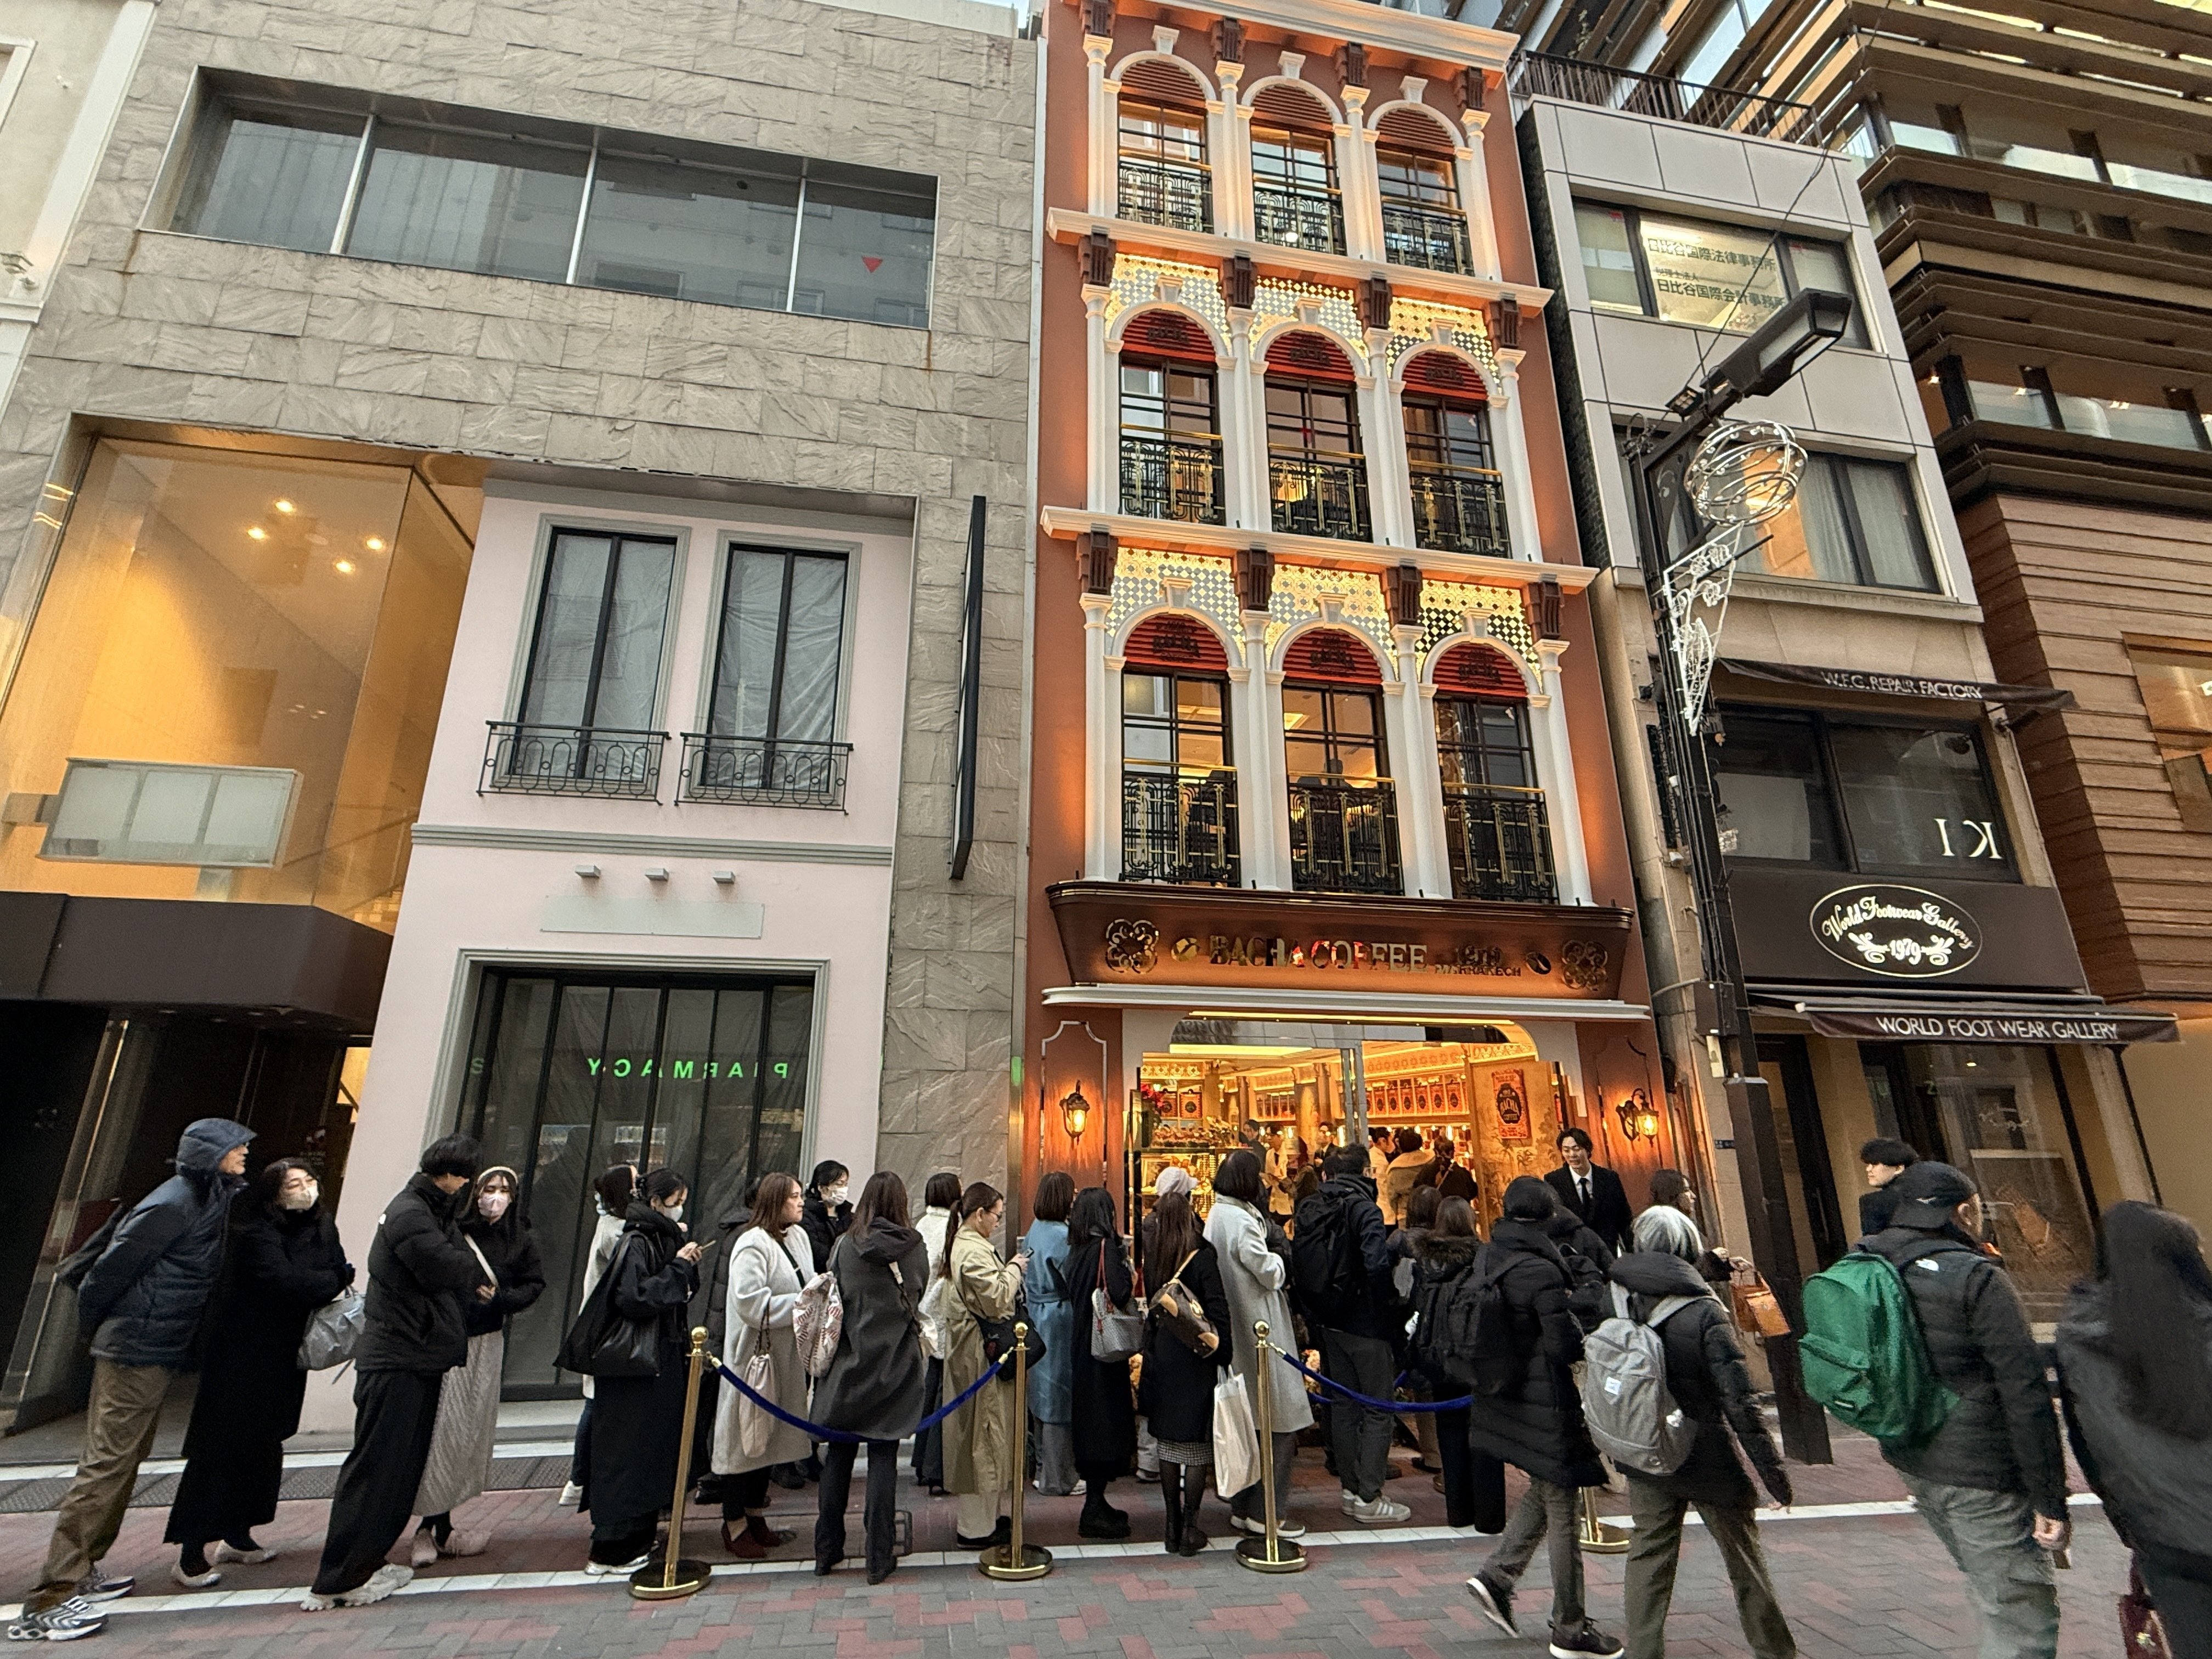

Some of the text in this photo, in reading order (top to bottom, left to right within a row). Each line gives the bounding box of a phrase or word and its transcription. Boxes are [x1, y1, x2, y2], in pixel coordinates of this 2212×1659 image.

[1920, 680, 1984, 699] FACTORY
[1821, 895, 1975, 950] World Footwear Gallery
[1210, 935, 1427, 973] BACHA COFFEE
[1889, 938, 1922, 966] 1979
[1435, 964, 1522, 977] MARRAKECH
[1876, 1016, 2119, 1040] WORLD FOOT WEAR GALLERY
